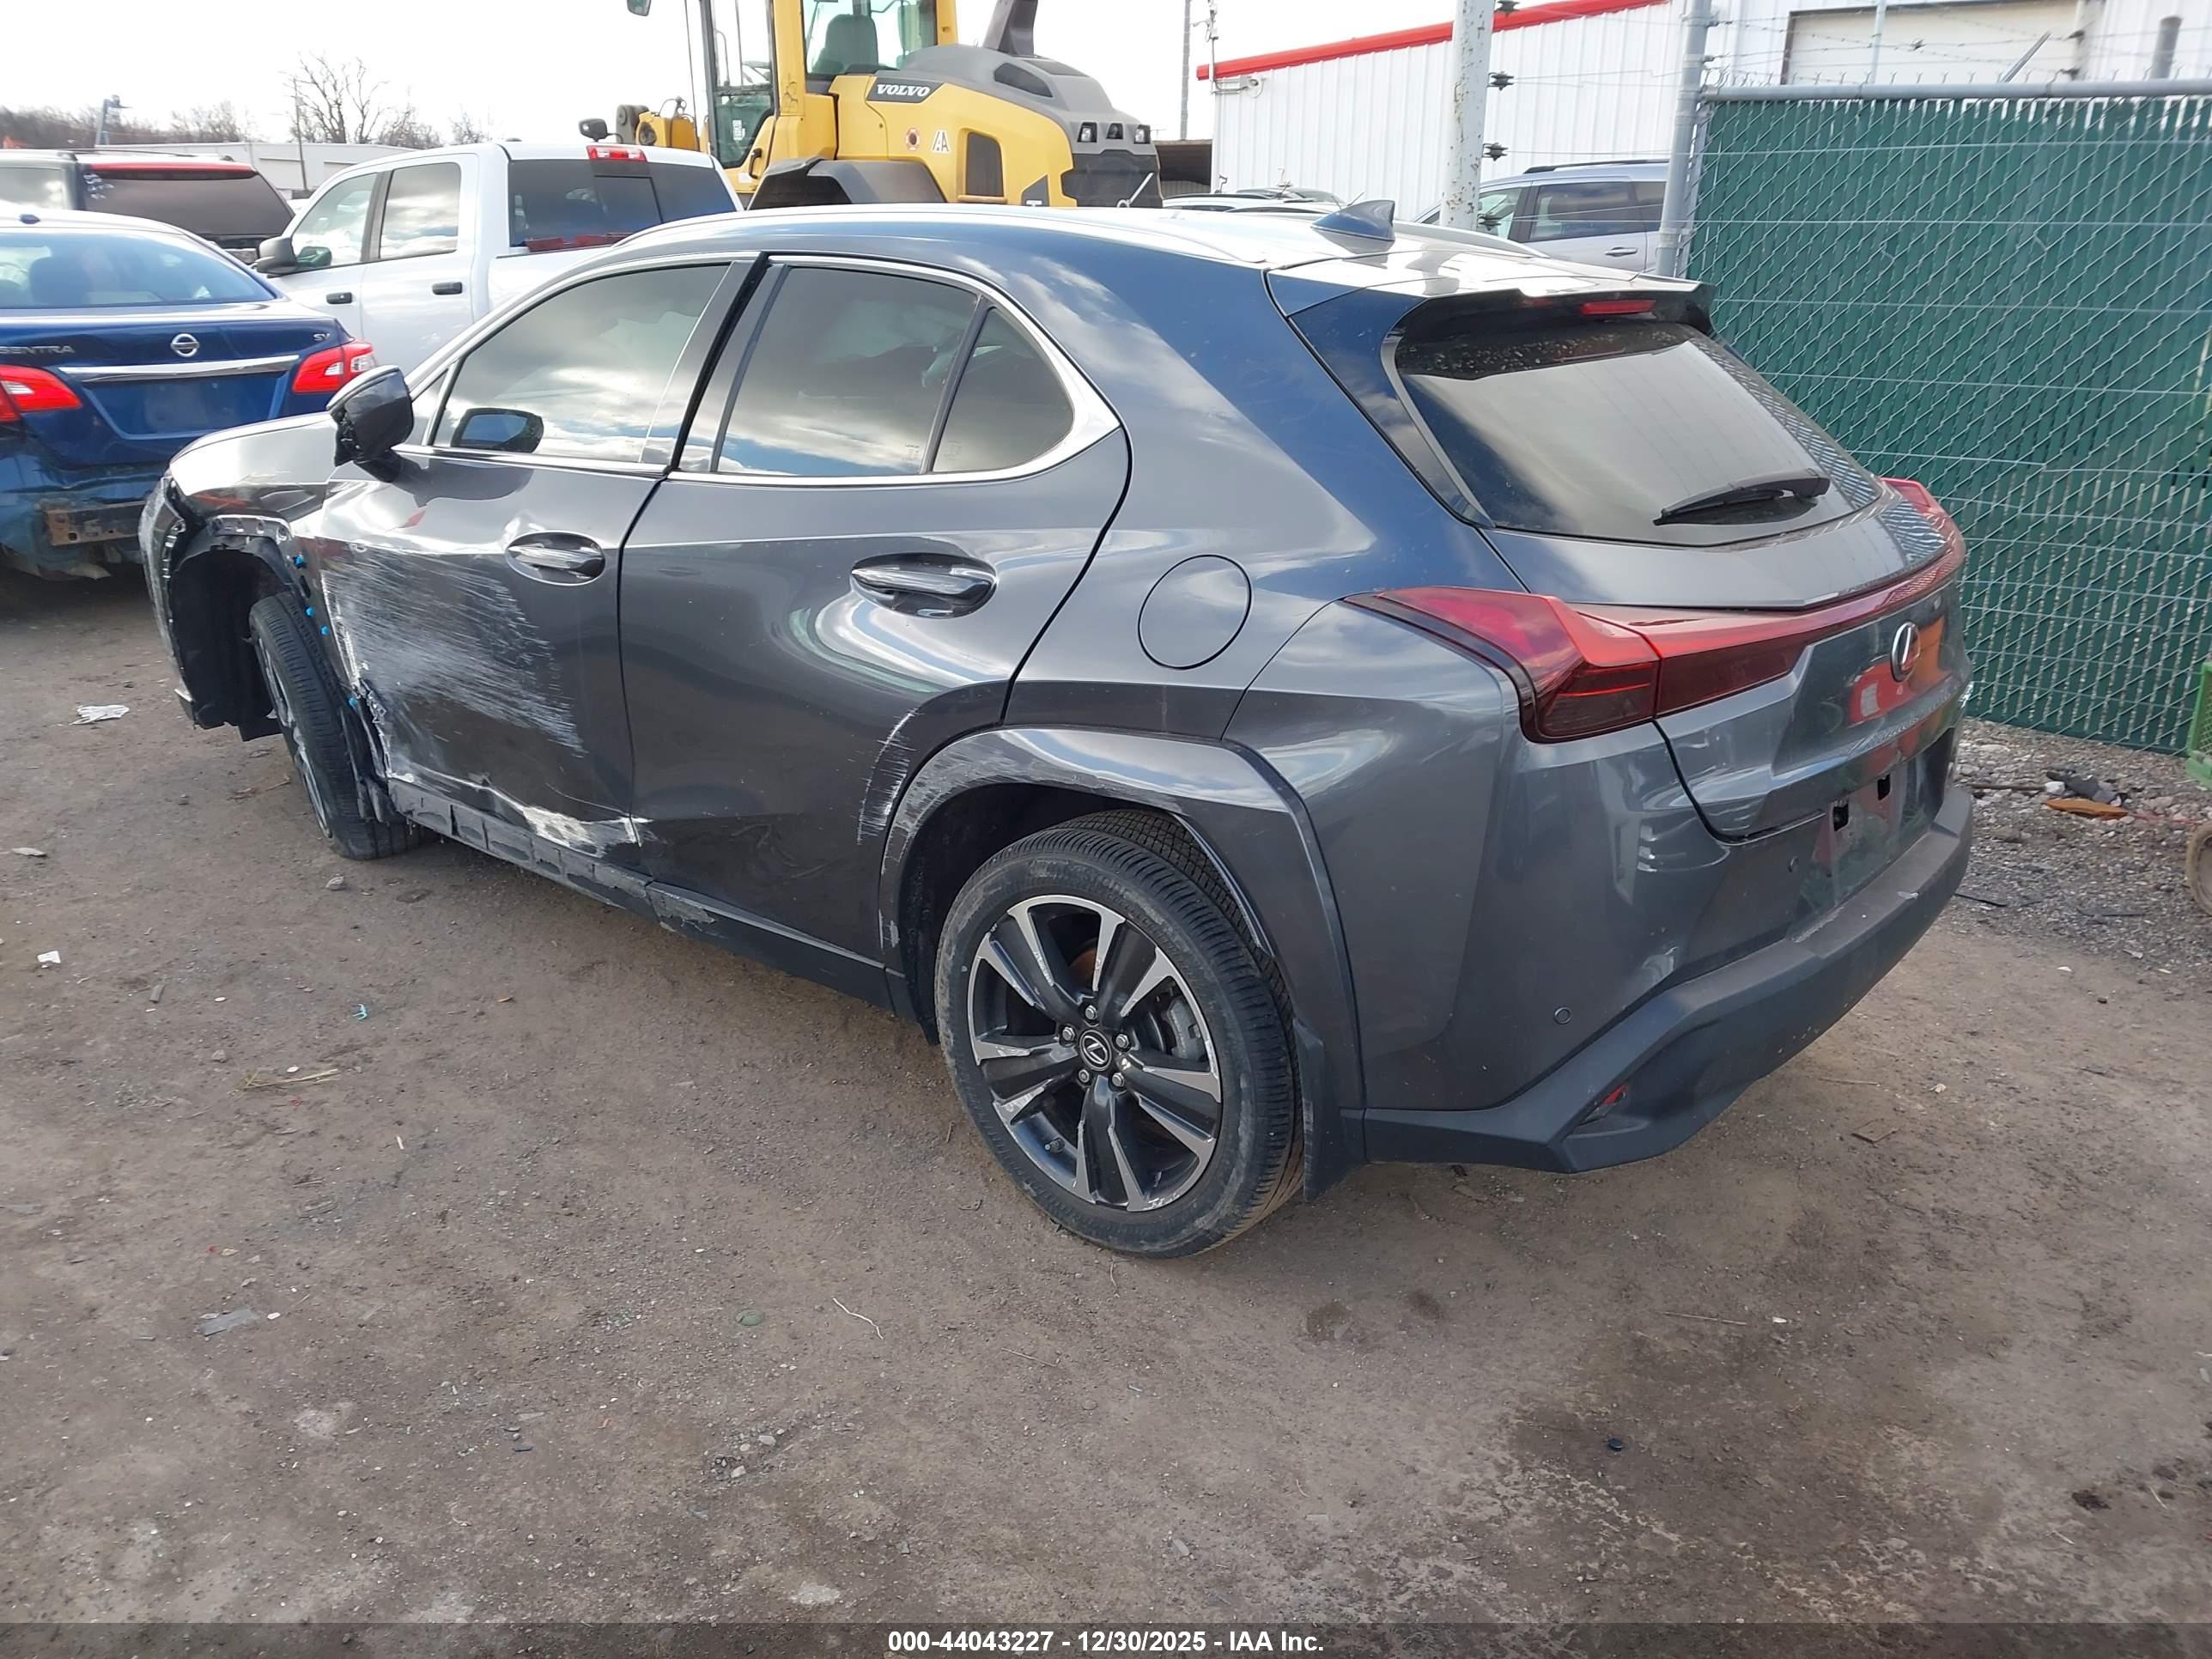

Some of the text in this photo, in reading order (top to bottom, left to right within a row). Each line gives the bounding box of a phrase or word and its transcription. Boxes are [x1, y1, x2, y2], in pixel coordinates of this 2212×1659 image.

[877, 84, 930, 97] VOLVO
[313, 332, 331, 342] SV
[0, 345, 76, 355] SENTRA
